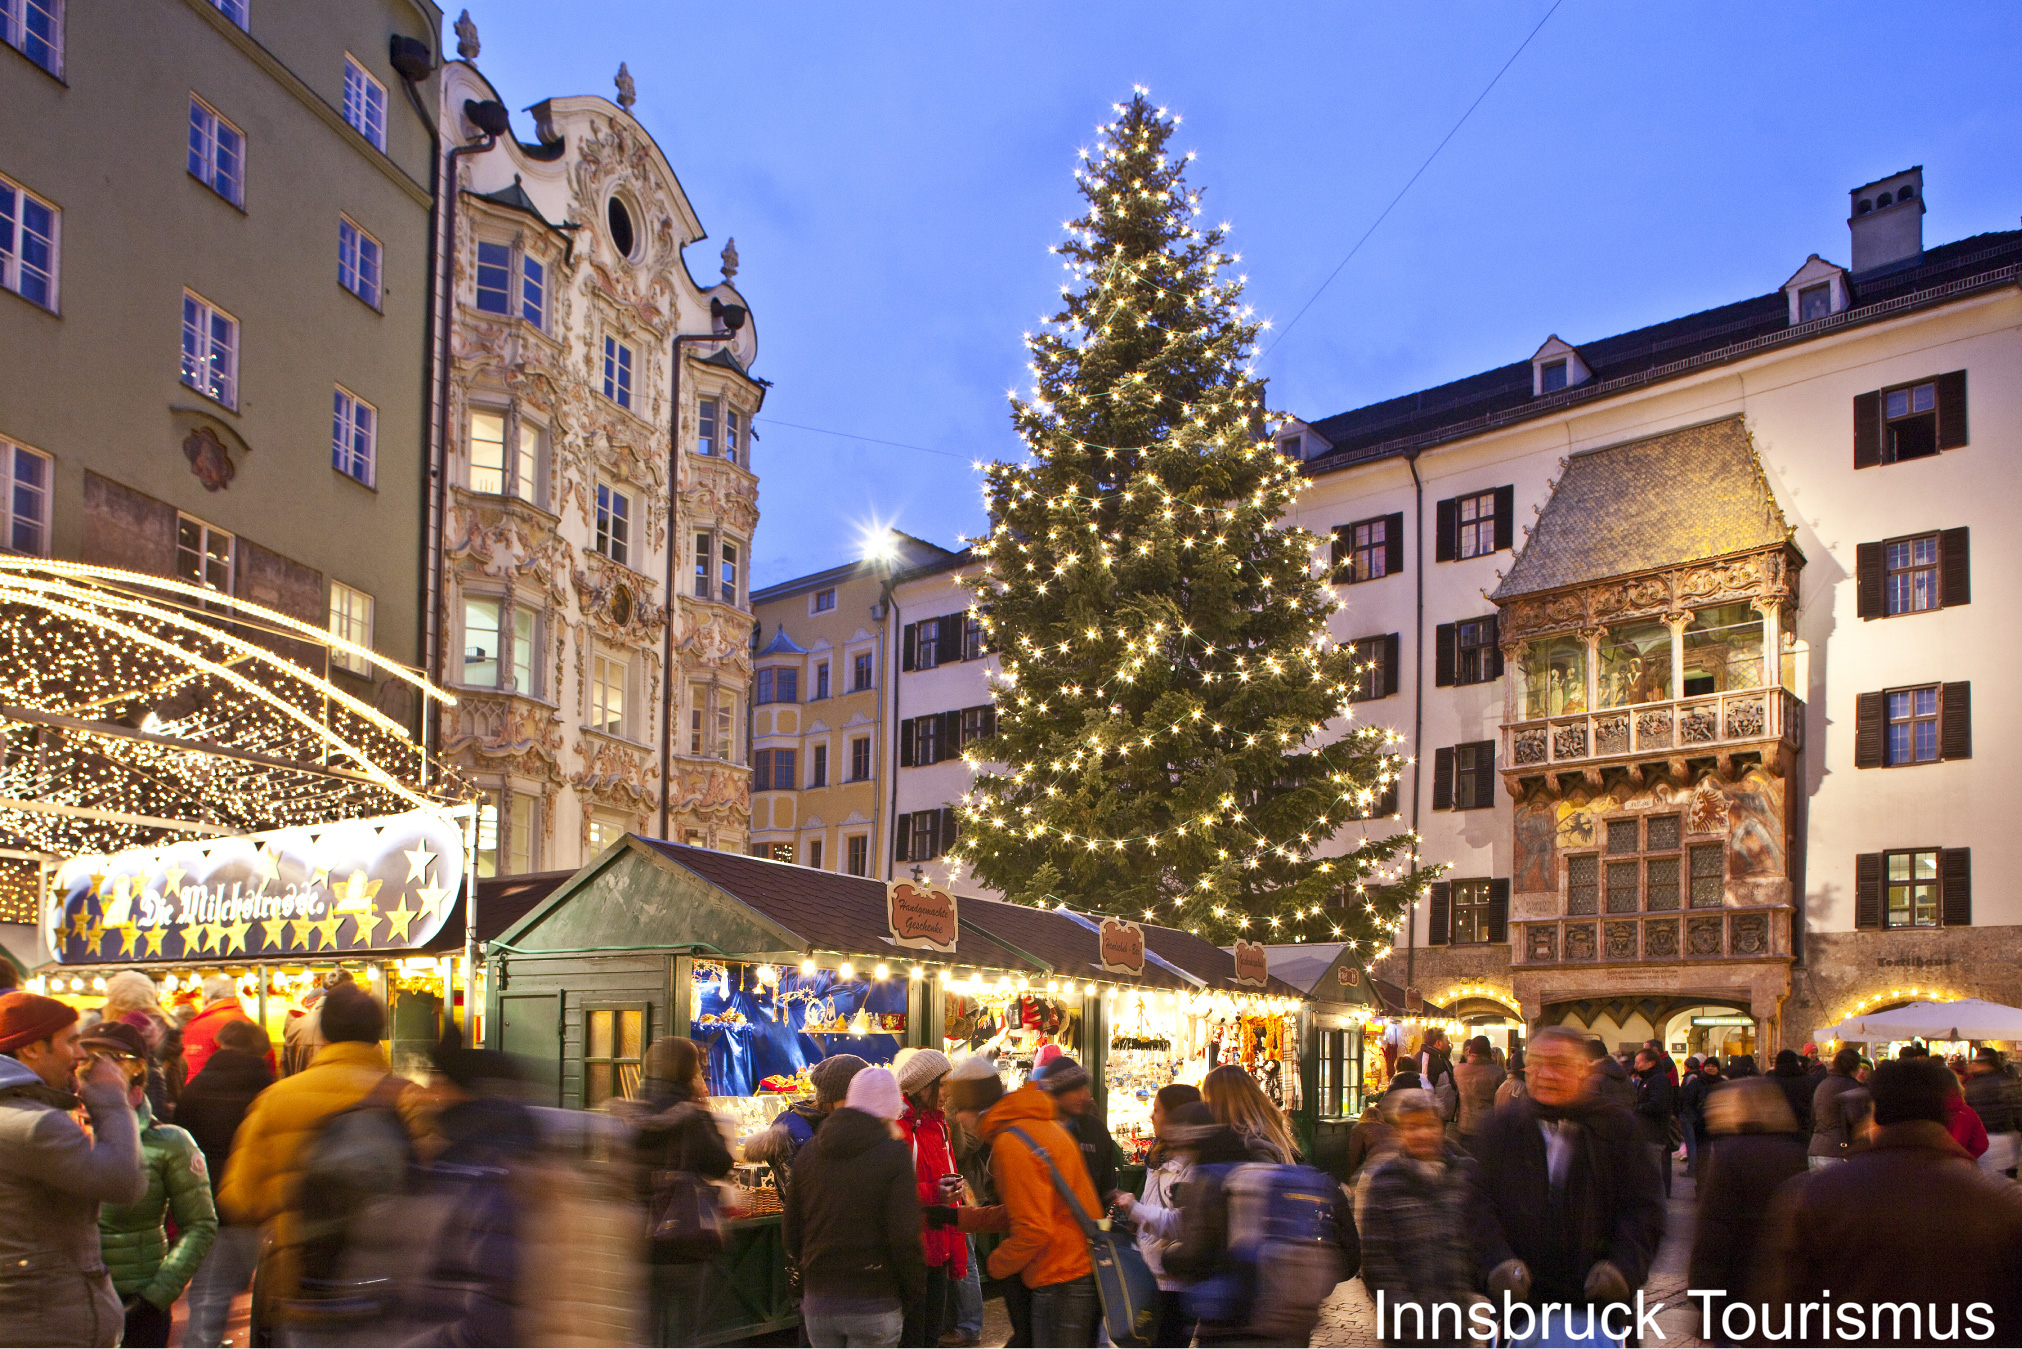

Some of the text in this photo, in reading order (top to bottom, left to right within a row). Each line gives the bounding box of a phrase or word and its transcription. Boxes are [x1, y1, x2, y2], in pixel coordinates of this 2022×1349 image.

[138, 888, 175, 927] Die
[898, 898, 949, 918] Handgemachte
[905, 916, 943, 934] Geschenke
